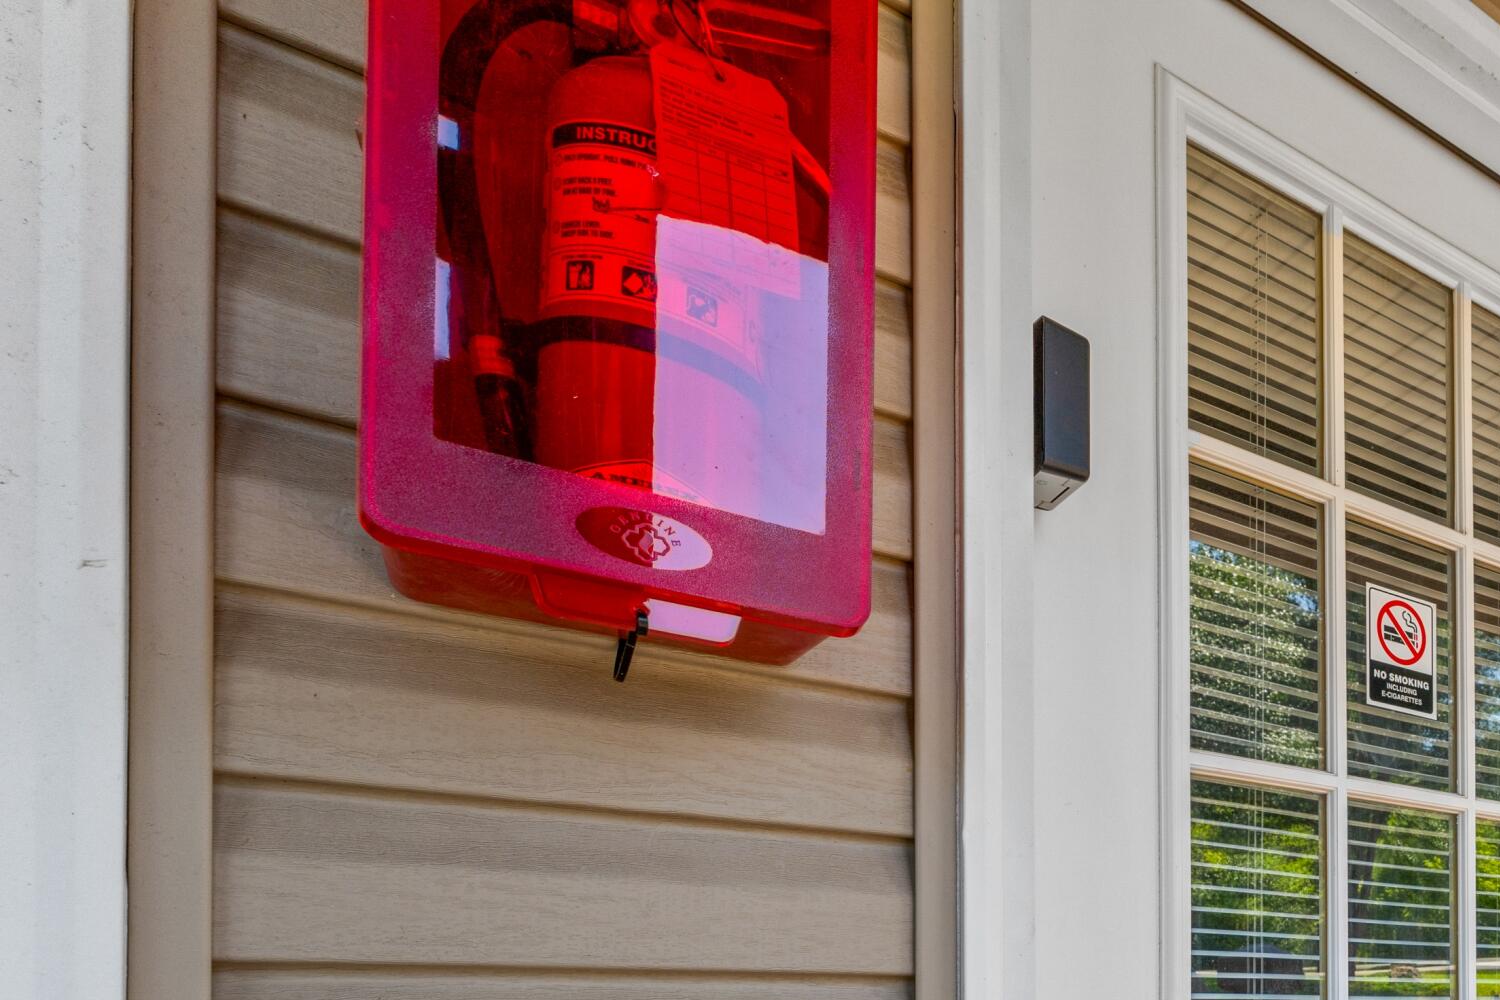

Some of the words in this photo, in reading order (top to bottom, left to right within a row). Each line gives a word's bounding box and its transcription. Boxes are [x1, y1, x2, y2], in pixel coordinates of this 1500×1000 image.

[1373, 668, 1387, 680] NO
[1389, 673, 1430, 690] SMOKING
[1386, 683, 1418, 696] INCLUDING
[1381, 690, 1423, 706] E-CIGARETTES
